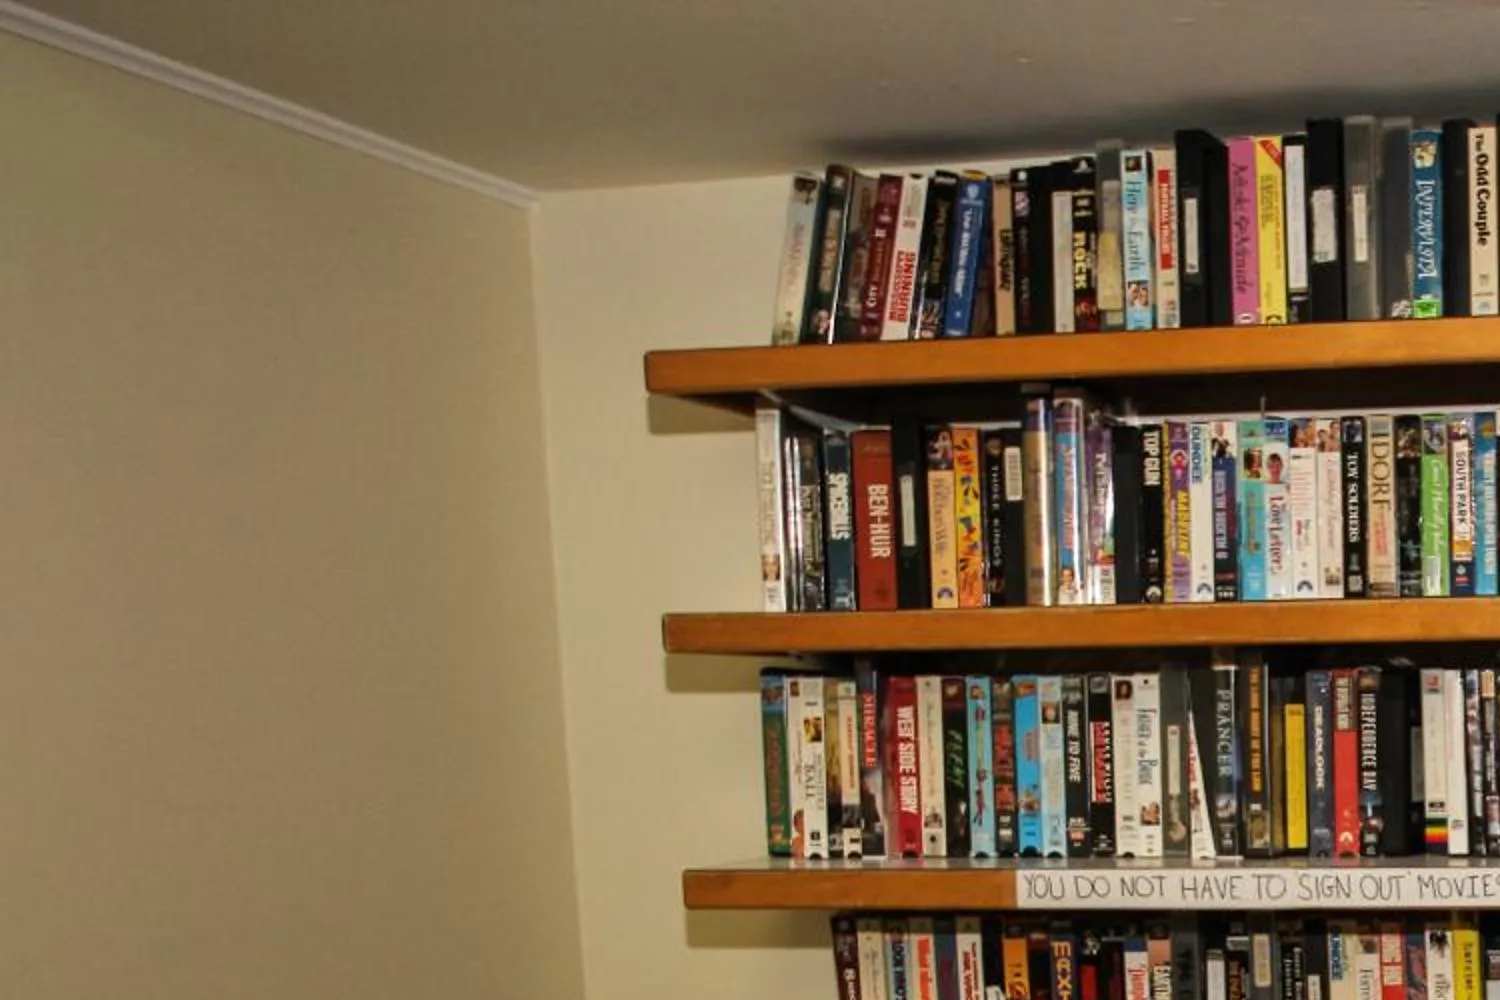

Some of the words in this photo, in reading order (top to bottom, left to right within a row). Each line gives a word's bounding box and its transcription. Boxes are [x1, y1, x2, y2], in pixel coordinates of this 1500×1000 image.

[1475, 153, 1490, 185] Odd
[1126, 181, 1142, 213] Here
[1414, 180, 1437, 280] INTERVISTA
[1473, 188, 1491, 246] Couple
[1074, 231, 1087, 289] ROCK
[1127, 231, 1145, 272] Earth
[1143, 431, 1160, 457] TOP
[1144, 459, 1160, 487] GUN
[1346, 452, 1360, 479] TOY
[1456, 450, 1468, 490] SOUTH
[867, 484, 891, 558] BEN-HUR
[1347, 483, 1361, 543] SOLDIERS
[1457, 494, 1469, 525] PARK
[896, 706, 915, 739] WEST
[1067, 709, 1080, 738] NINE
[1215, 689, 1233, 779] PRANCER
[1361, 693, 1377, 769] INDEPENDENCE
[899, 742, 916, 773] SIDE
[1069, 740, 1080, 754] TO
[1314, 706, 1325, 790] DEADLOCK
[1068, 757, 1081, 783] FIVE
[1363, 772, 1377, 792] DAY
[900, 776, 918, 815] STORY
[1024, 874, 1065, 899] YOU
[1074, 875, 1110, 898] DO
[1121, 874, 1166, 898] NOT
[1181, 874, 1244, 900] HAVE
[1252, 873, 1287, 899] TO
[1300, 874, 1352, 900] SIGN
[1360, 873, 1403, 899] OUT
